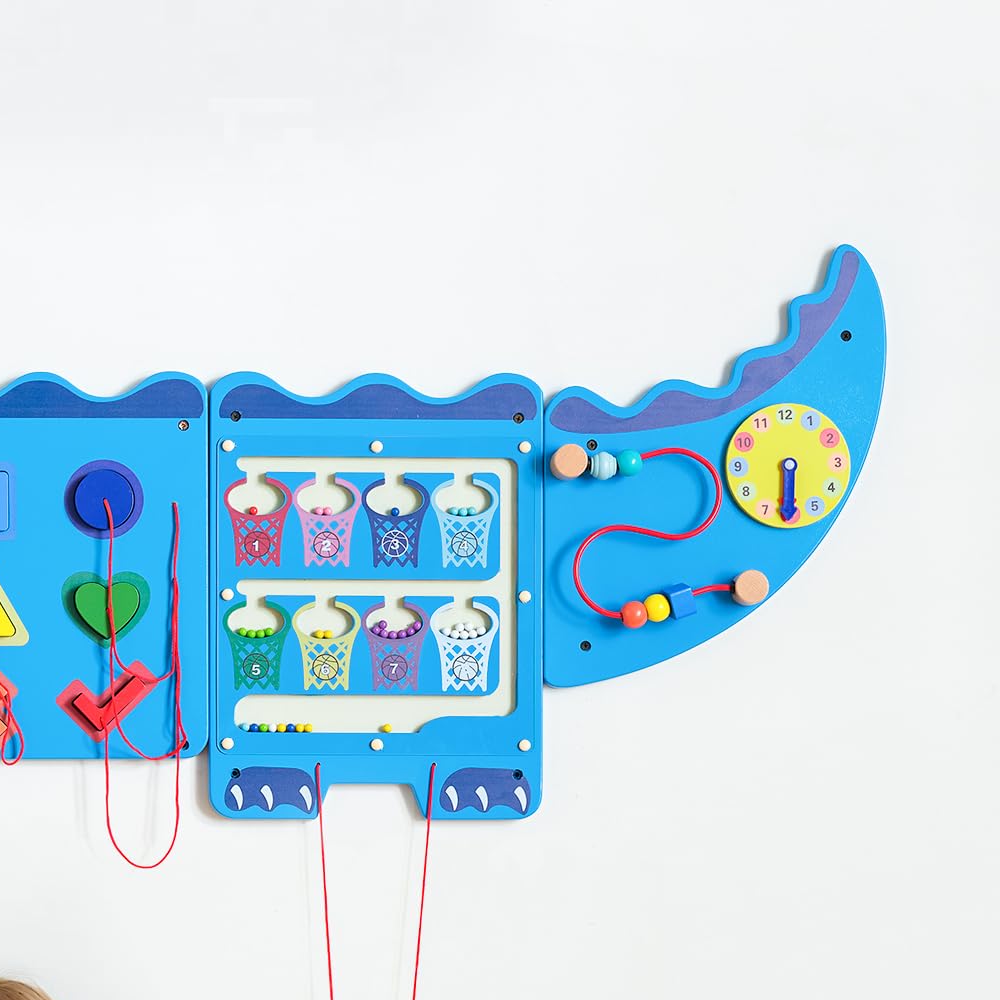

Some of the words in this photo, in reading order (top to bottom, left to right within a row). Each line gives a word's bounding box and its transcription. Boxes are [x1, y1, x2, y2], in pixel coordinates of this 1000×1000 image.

[778, 409, 792, 420] 12
[754, 418, 767, 428] 11
[807, 415, 812, 426] 1
[737, 437, 751, 448] 10
[827, 433, 834, 443] 2
[734, 462, 741, 472] 9
[834, 457, 841, 467] 3
[742, 486, 750, 496] 8
[828, 482, 835, 492] 4
[762, 505, 768, 515] 7
[811, 501, 818, 511] 5
[252, 540, 260, 551] 1
[322, 540, 331, 551] 2
[391, 540, 400, 550] 3
[460, 540, 468, 551] 4
[252, 664, 261, 675] 5
[321, 664, 330, 675] 6
[390, 664, 398, 674] 7
